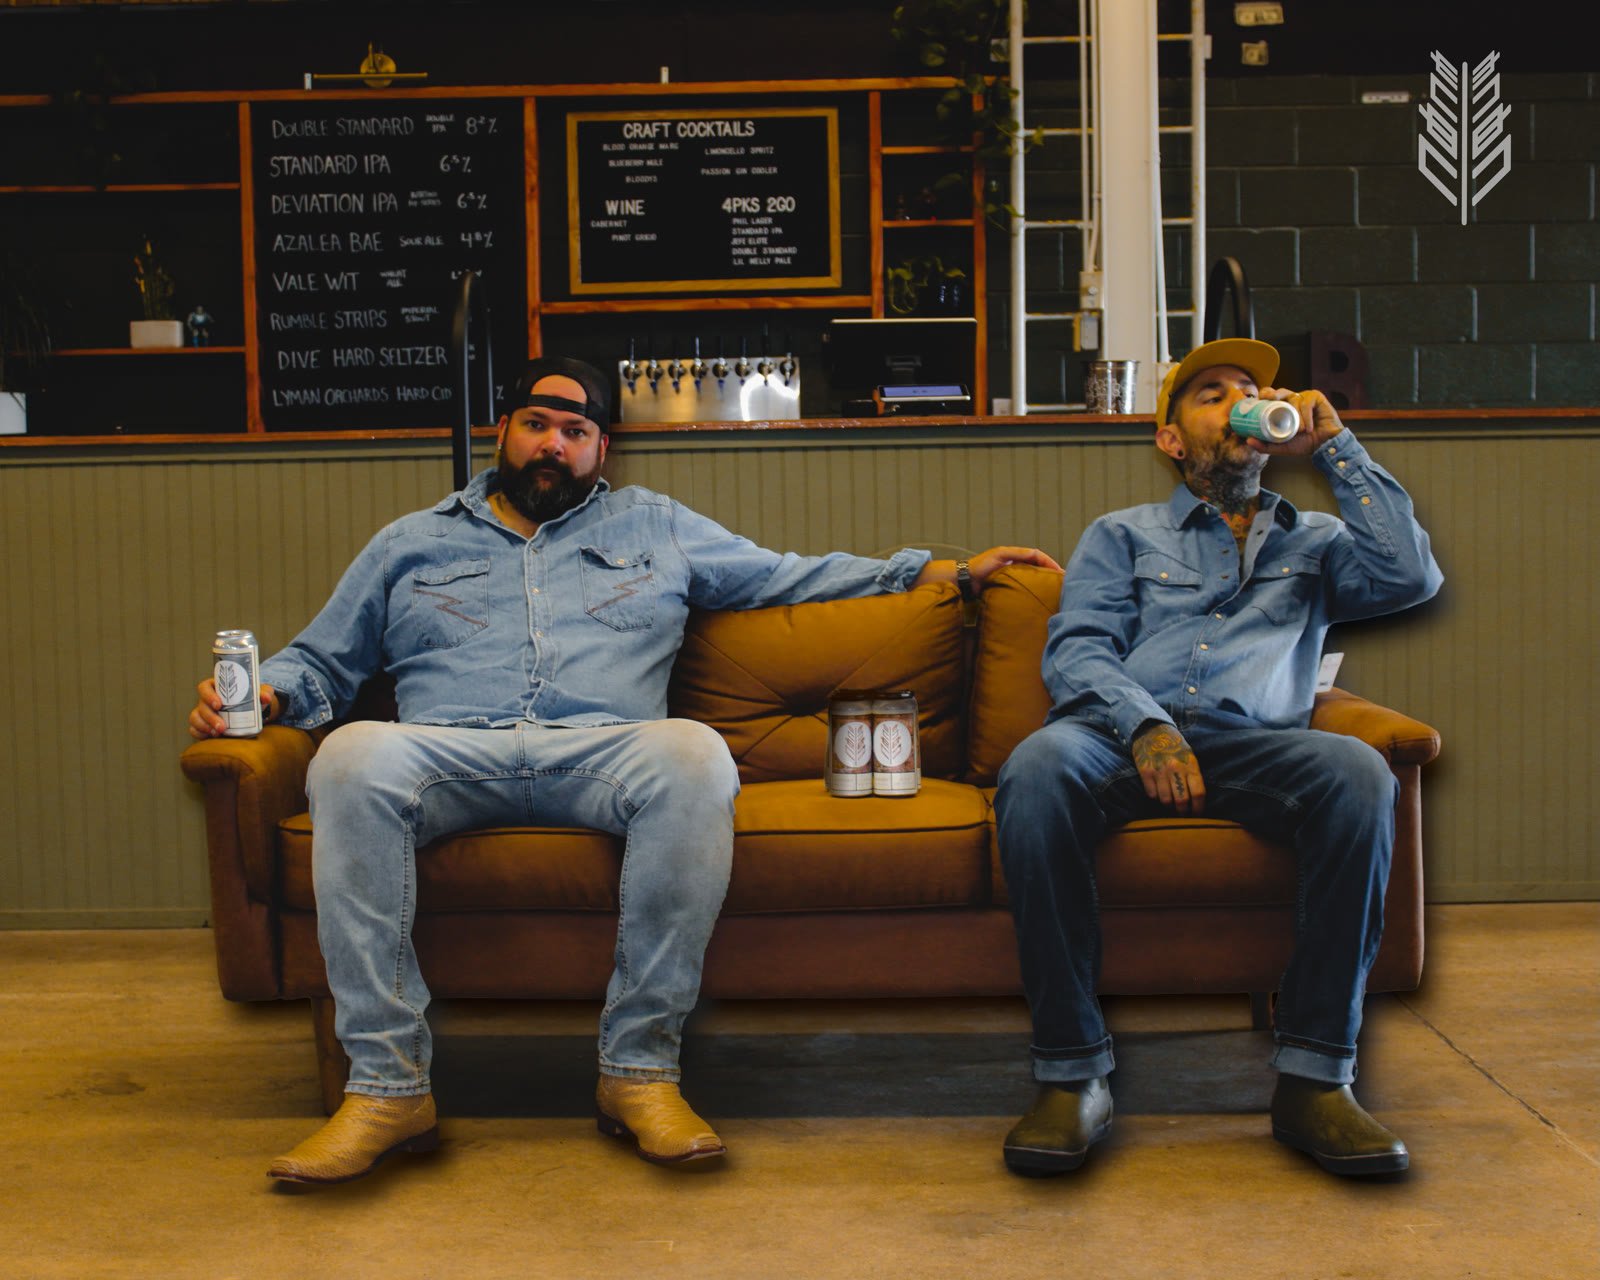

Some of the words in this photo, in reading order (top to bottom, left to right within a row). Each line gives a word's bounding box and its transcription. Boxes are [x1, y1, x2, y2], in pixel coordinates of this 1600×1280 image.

[272, 120, 327, 139] DOUBLE
[336, 116, 414, 135] STANDARD
[622, 122, 672, 138] CRAFT
[676, 120, 755, 137] COCKTAILS
[271, 155, 357, 177] STANDARD
[364, 154, 390, 174] IPA
[272, 193, 363, 214] DEVIATION
[373, 192, 398, 212] IPA
[606, 200, 645, 215] WINE
[722, 197, 760, 213] 4PKS
[767, 196, 795, 213] 2GO
[591, 220, 627, 228] CABERNET
[273, 234, 341, 252] AZALEA
[350, 232, 382, 252] BAE
[762, 247, 797, 255] STANDARD
[272, 272, 318, 292] VALE
[324, 272, 359, 290] WIT
[270, 313, 327, 331] RUMBLE
[335, 309, 387, 329] STRIPS
[278, 350, 320, 370] DIVE
[333, 347, 374, 367] HARD
[380, 346, 448, 366] SELTZER
[273, 388, 320, 406] LYMAN
[324, 388, 388, 405] ORCHARDS
[397, 386, 429, 401] HARD
[431, 386, 452, 400] CID
